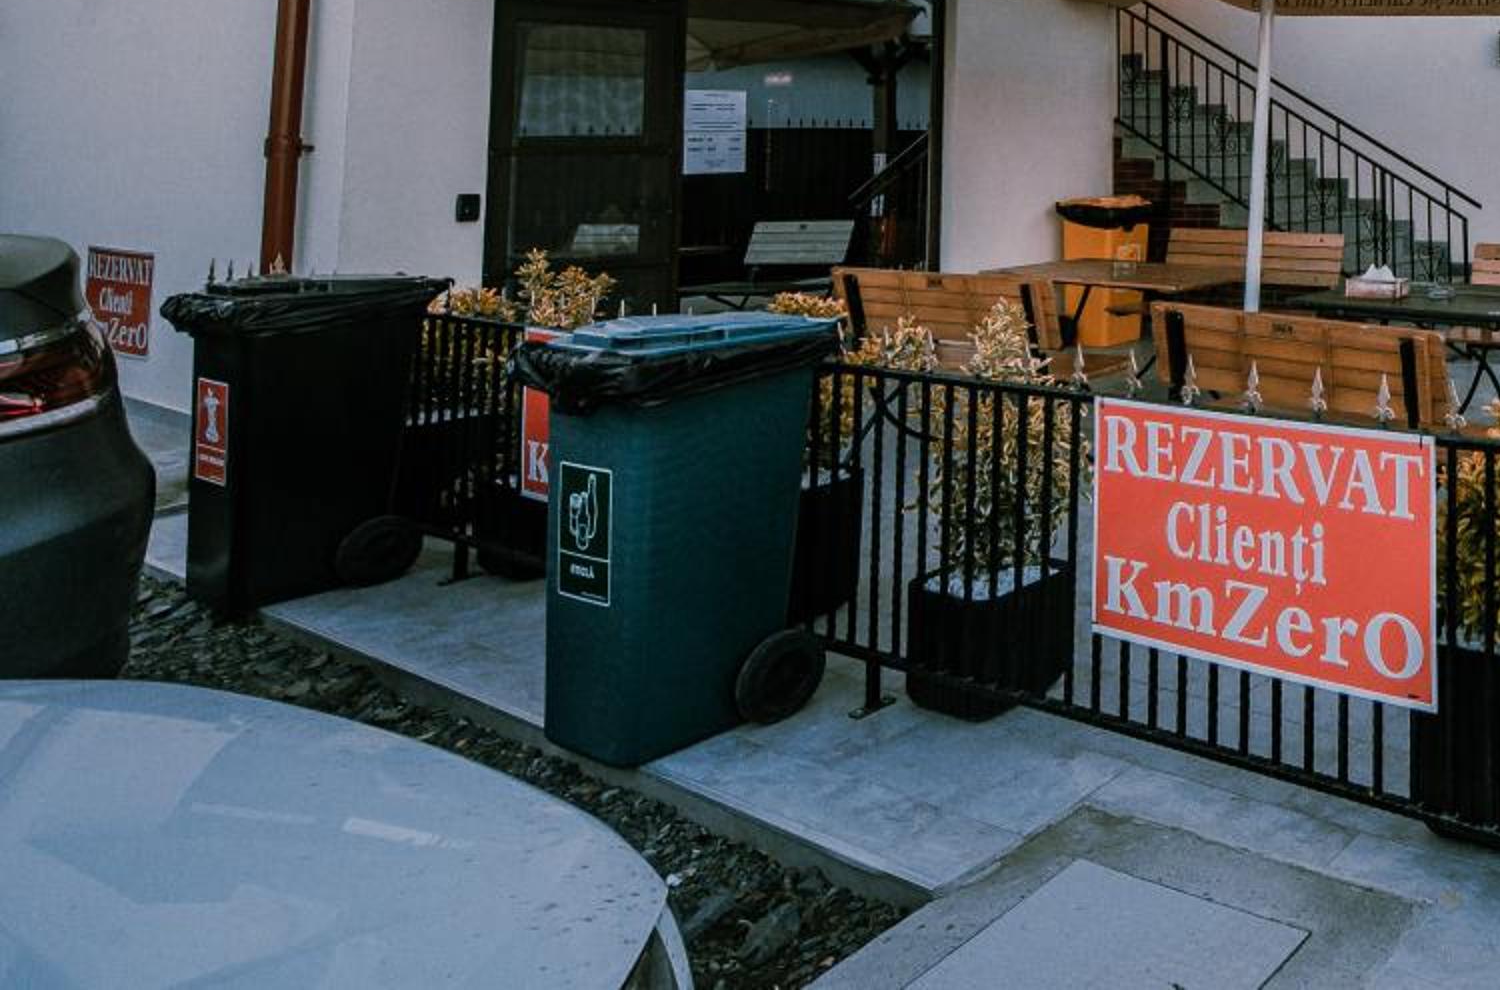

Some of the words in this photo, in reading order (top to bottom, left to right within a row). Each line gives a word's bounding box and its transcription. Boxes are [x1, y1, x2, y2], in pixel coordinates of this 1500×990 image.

[88, 252, 151, 286] REZERVAT
[1104, 415, 1424, 521] REZERVAT
[1166, 500, 1327, 595] Clienți
